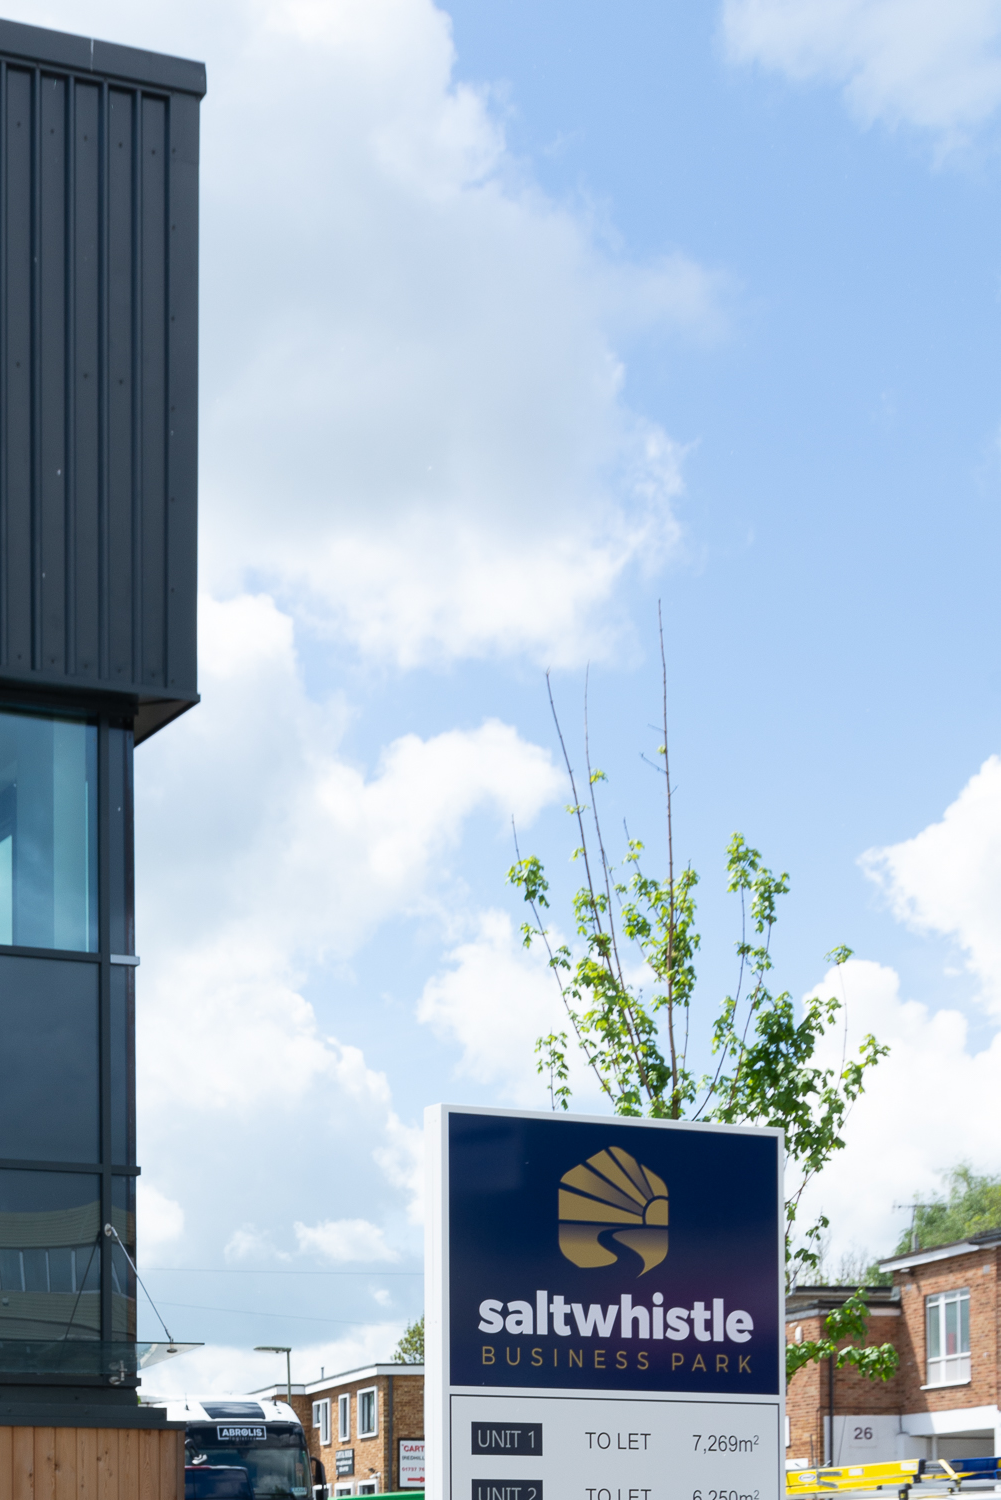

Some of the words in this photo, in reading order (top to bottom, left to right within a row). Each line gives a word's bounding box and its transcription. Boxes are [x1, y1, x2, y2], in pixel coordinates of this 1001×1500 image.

[478, 1290, 754, 1344] saltwhistle
[482, 1345, 649, 1370] BUSINESS
[671, 1352, 752, 1373] PARK
[222, 1428, 263, 1437] ABROLIS
[478, 1430, 522, 1448] UNIT
[528, 1431, 535, 1448] 1
[585, 1432, 612, 1450] TO
[617, 1432, 652, 1450] LET
[854, 1427, 873, 1440] 26
